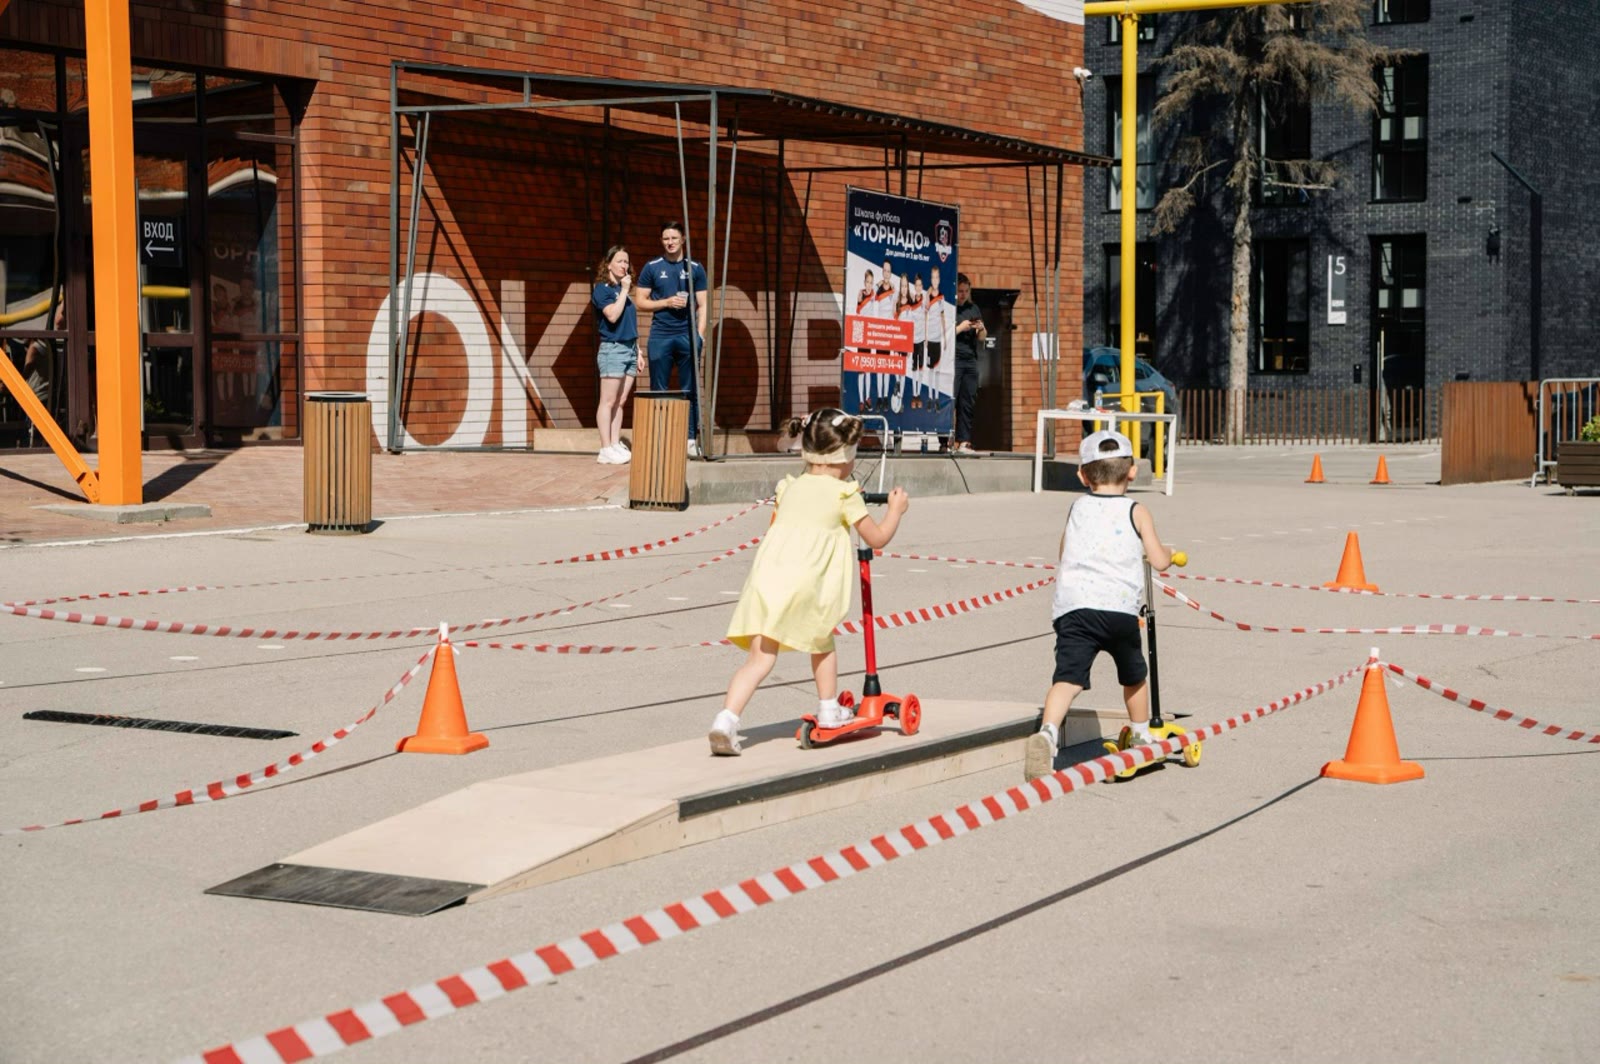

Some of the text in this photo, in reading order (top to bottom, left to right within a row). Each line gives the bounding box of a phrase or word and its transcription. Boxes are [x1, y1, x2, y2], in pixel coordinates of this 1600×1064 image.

[144, 221, 175, 242] ВХОД
[853, 222, 931, 252] «ТОРНАДО»
[1334, 256, 1346, 275] 5
